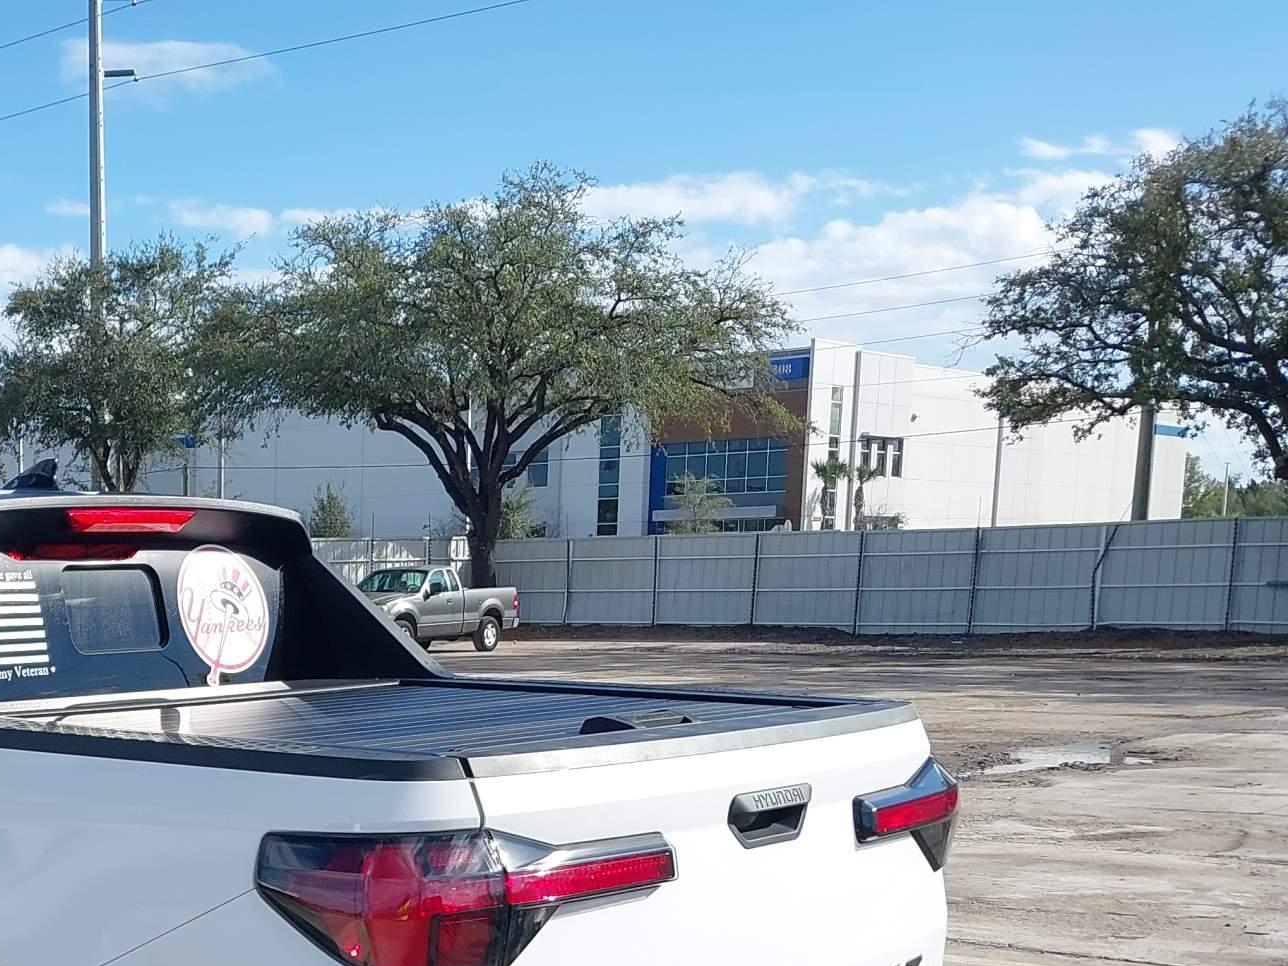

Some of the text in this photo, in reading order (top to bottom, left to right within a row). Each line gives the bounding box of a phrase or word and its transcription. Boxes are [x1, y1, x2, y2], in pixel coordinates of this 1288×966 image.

[5, 571, 22, 582] gave
[23, 569, 33, 580] all
[182, 587, 265, 643] Yankees
[14, 665, 49, 678] Veteran
[752, 787, 805, 809] HYUNDAI
